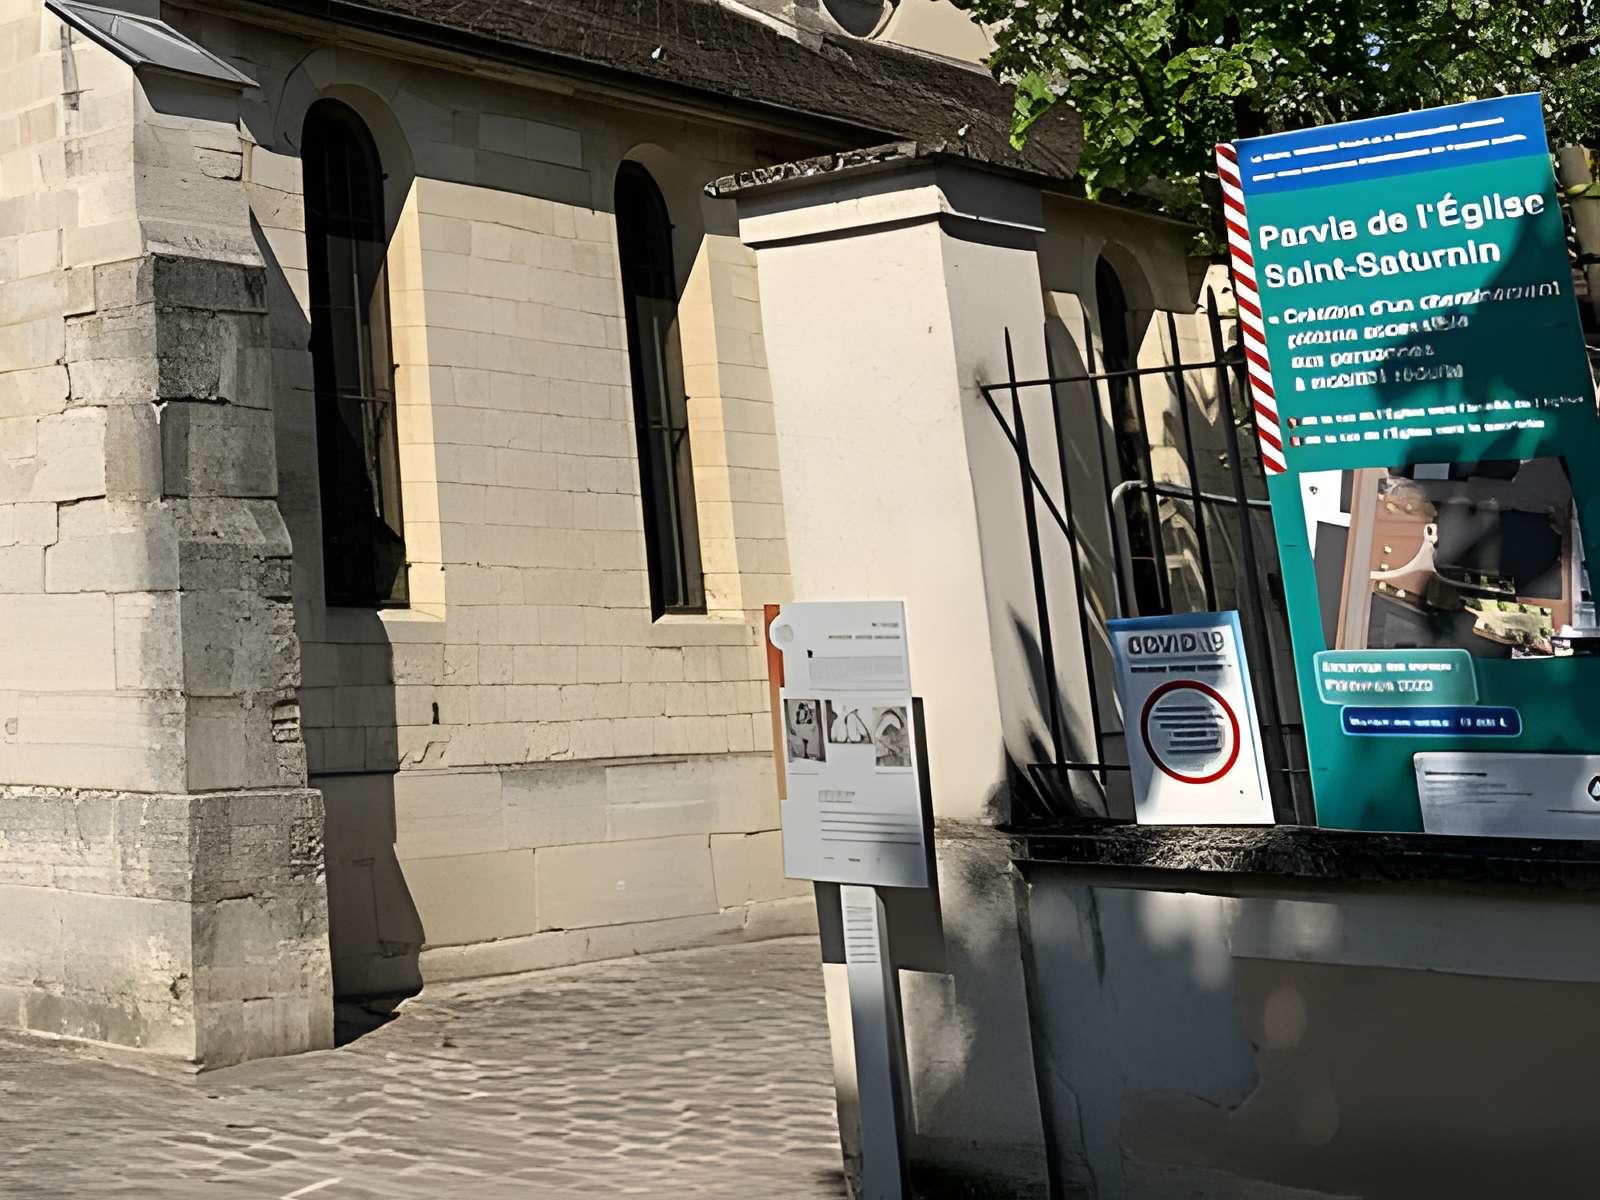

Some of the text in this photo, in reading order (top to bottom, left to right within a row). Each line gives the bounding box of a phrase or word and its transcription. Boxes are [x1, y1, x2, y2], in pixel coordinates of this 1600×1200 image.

[1259, 216, 1357, 250] Parvis
[1367, 209, 1408, 236] de
[1264, 240, 1501, 288] Saint-Saturnin
